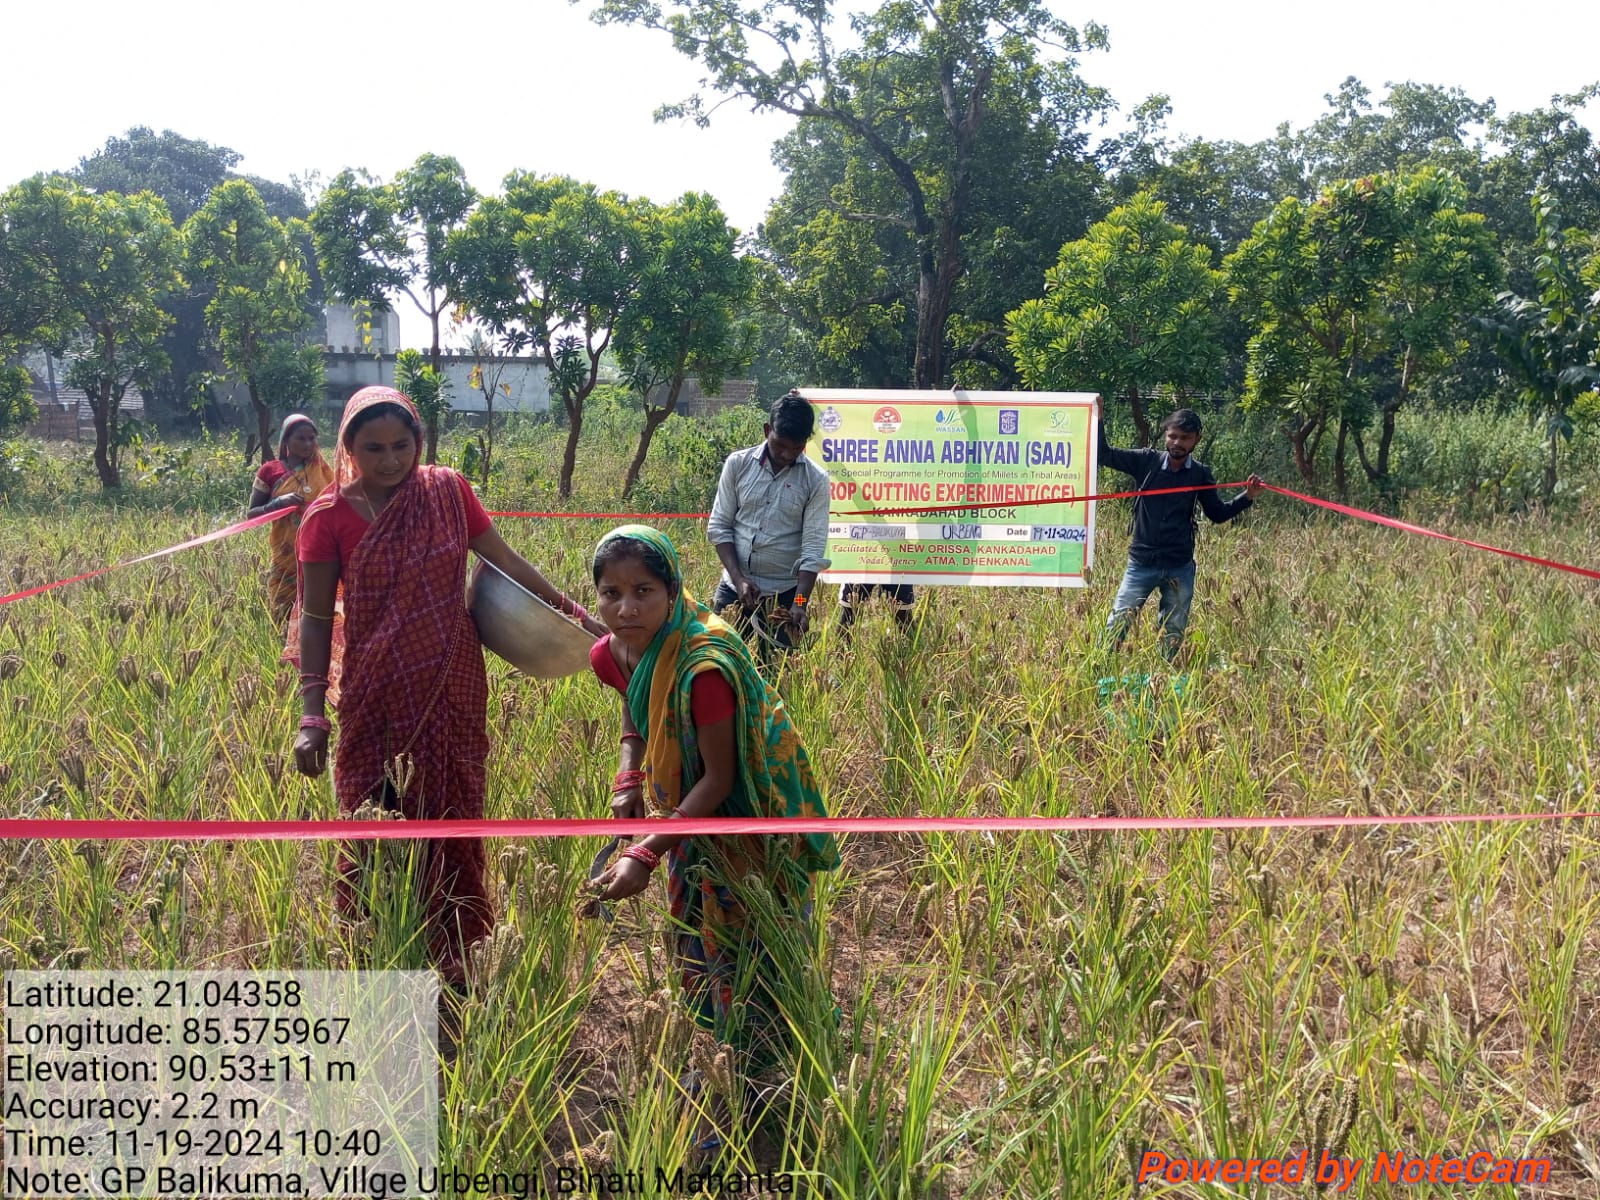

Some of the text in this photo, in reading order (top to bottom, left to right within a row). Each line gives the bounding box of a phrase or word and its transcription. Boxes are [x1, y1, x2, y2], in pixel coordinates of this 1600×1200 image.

[822, 438, 1071, 469] SHREE ANNA ABHIYAN (SAA)
[841, 469, 871, 478] Special
[874, 469, 921, 479] Programme
[938, 470, 979, 478] Promotion
[992, 471, 1018, 479] Millets
[1021, 471, 1028, 479] in
[1031, 471, 1052, 479] Tribal
[1054, 472, 1081, 480] Areas)
[830, 482, 1075, 508] ROP CUTTING EXPERIMENT(CCE)
[971, 508, 1016, 519] BLOCK
[1006, 528, 1028, 536] Date
[832, 544, 877, 552] Facilitated
[881, 544, 891, 554] by
[899, 544, 925, 553] NEW
[928, 545, 973, 555] ORISSA,
[977, 546, 1056, 555] KANKADAHAD
[859, 556, 885, 565] Nodal
[888, 557, 917, 567] Agency
[925, 557, 959, 567] ATMA,
[962, 557, 1032, 566] DHENKANAL
